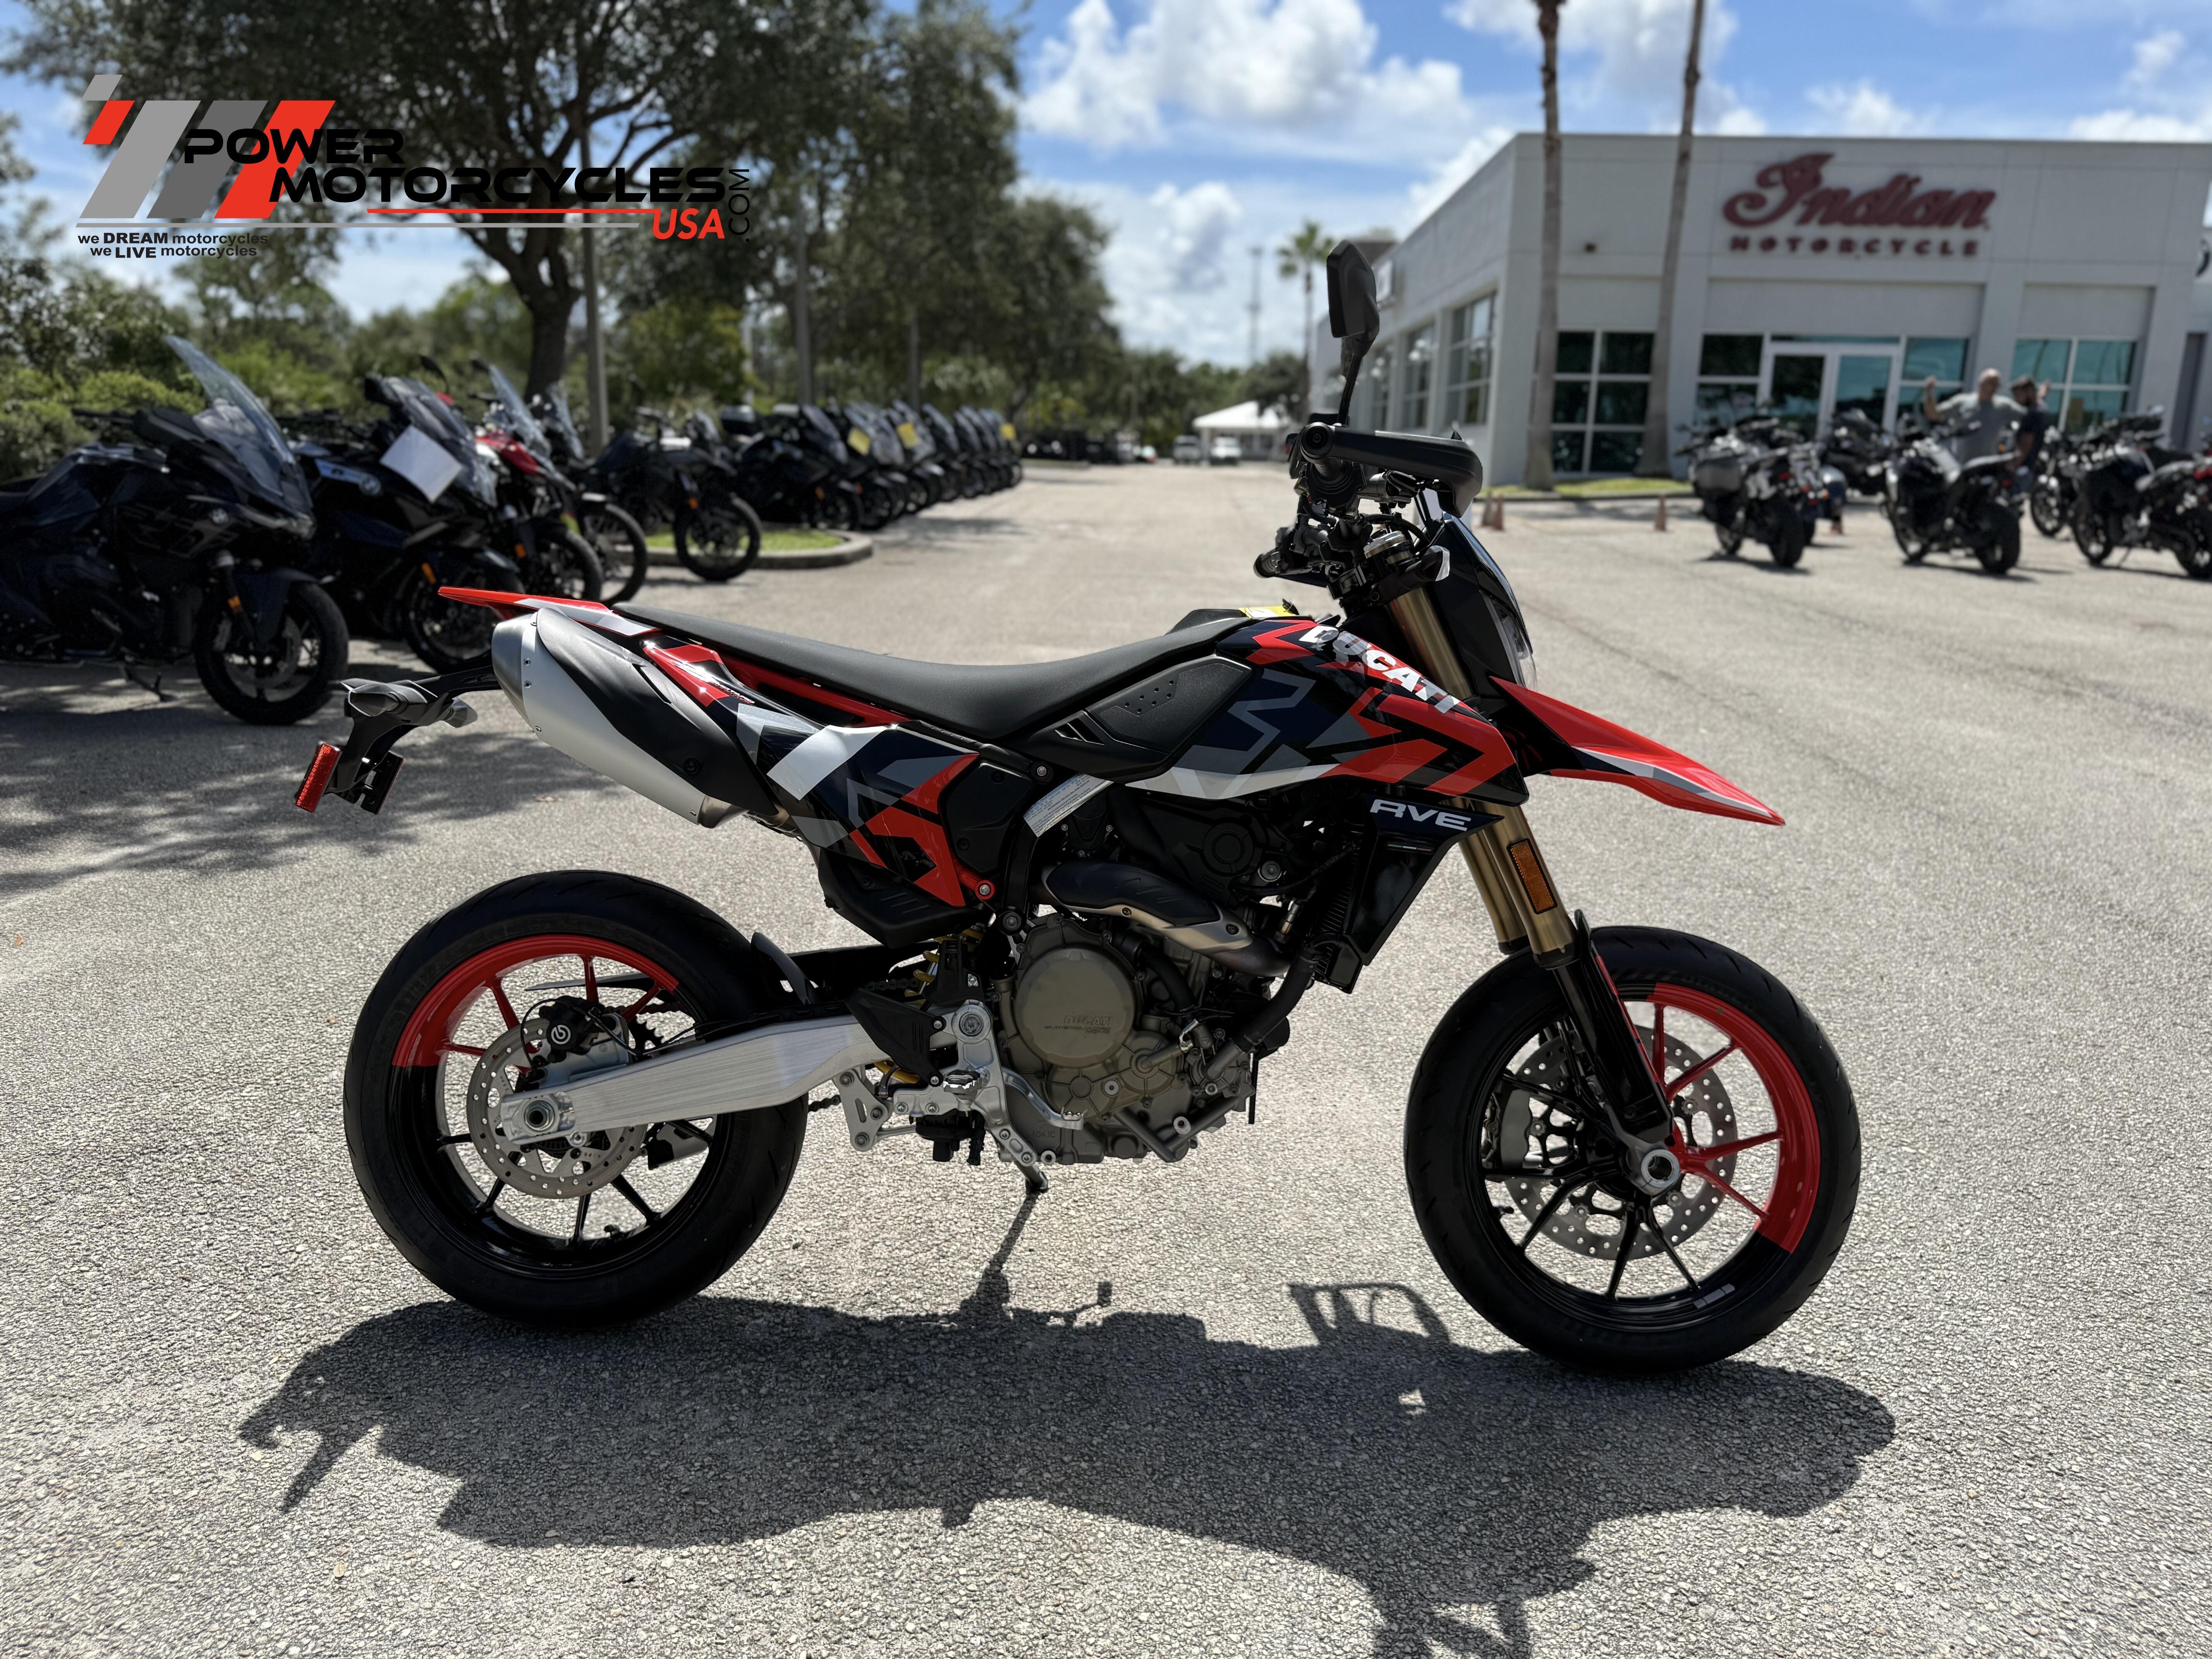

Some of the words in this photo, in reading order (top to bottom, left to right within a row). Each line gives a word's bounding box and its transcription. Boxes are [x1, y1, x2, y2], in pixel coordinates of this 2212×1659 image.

[1723, 153, 1996, 228] Indian
[1730, 236, 1980, 256] MOTORCYCLE
[1299, 625, 1460, 714] DUCATI
[1370, 799, 1472, 831] RVE
[1063, 1015, 1113, 1026] DUCATI
